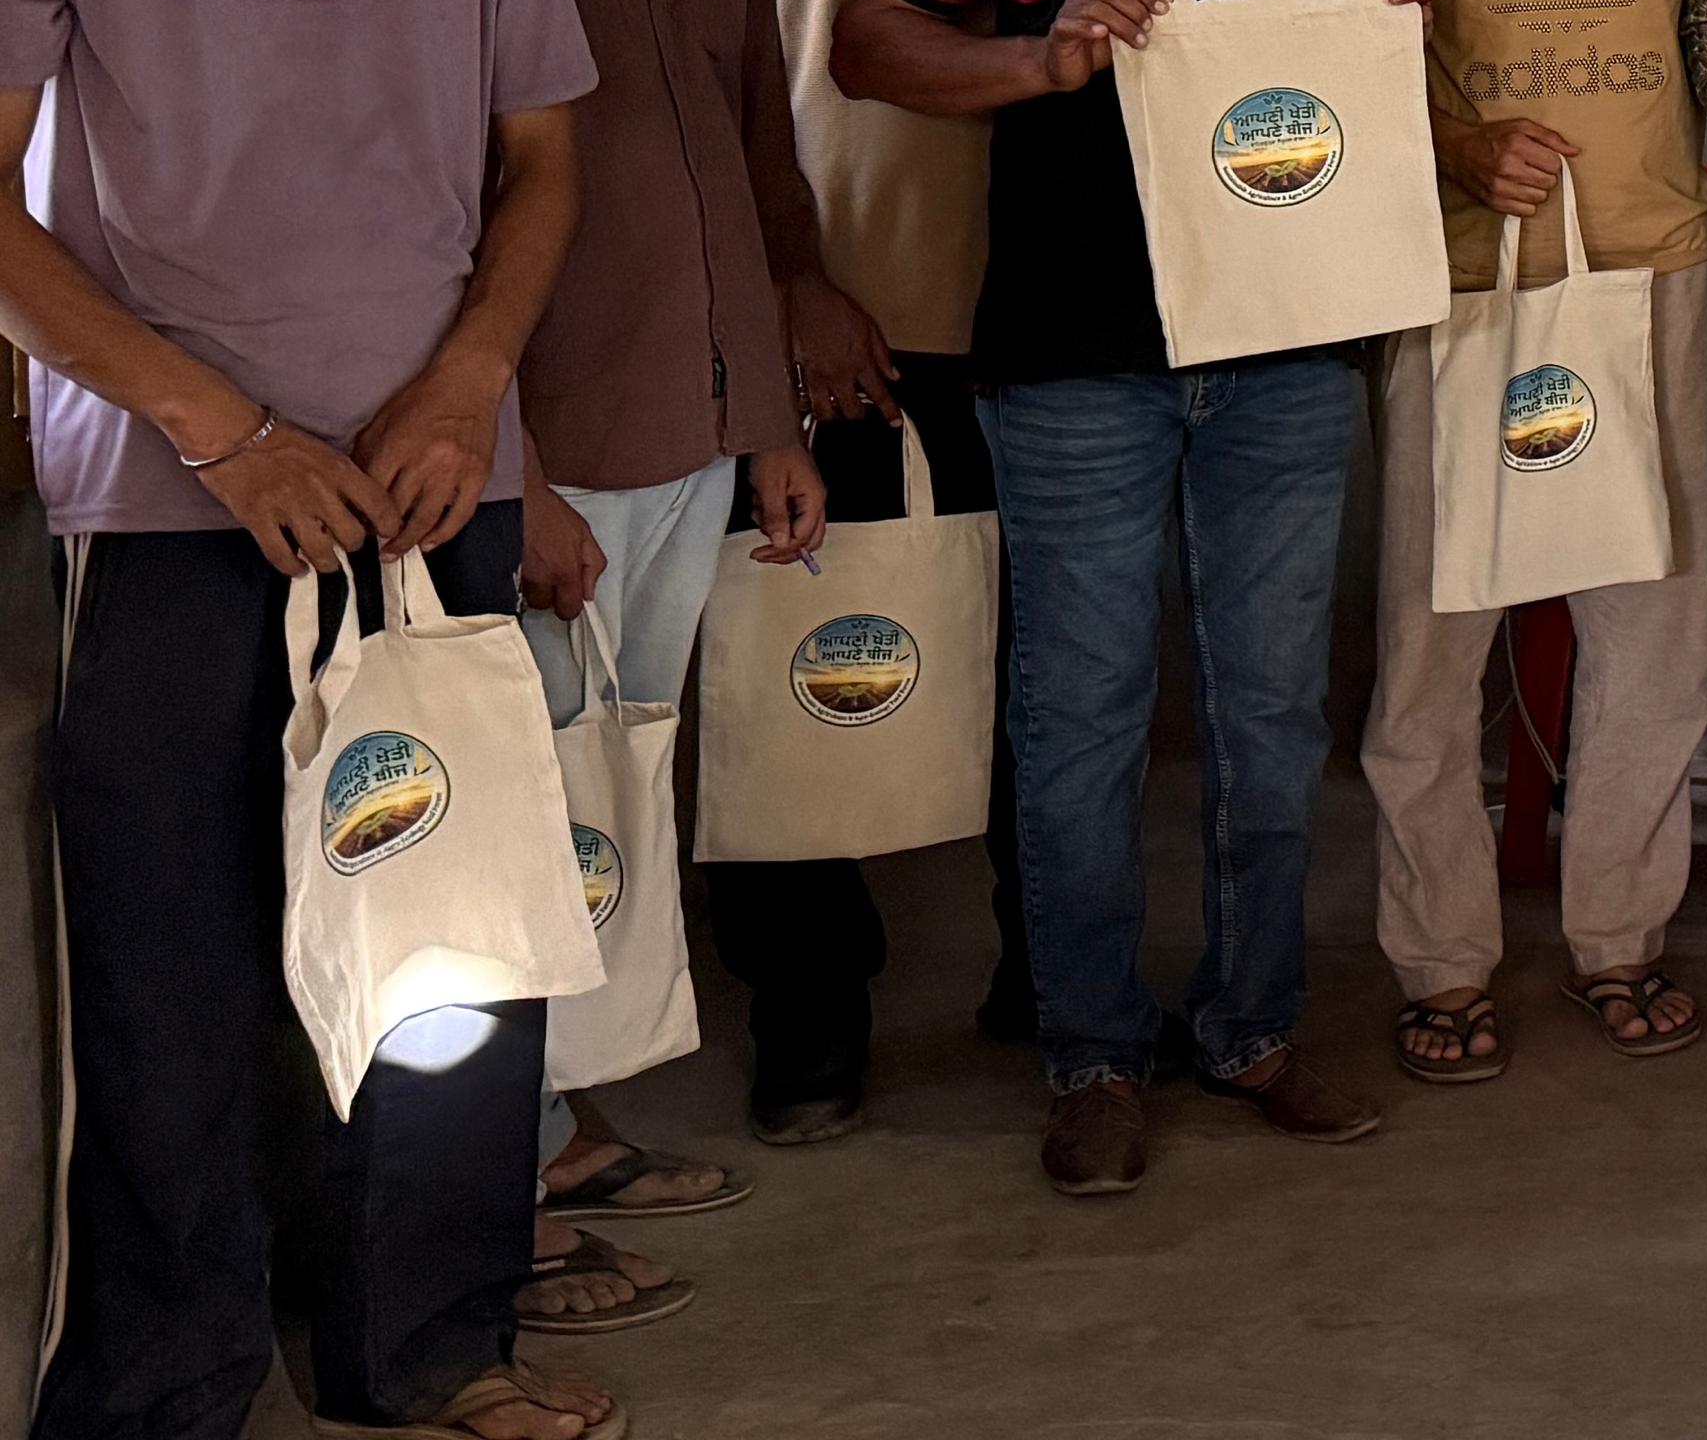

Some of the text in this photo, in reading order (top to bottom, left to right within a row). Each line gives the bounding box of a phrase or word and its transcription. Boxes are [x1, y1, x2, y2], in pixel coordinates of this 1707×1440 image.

[1463, 44, 1664, 101] adidas
[1232, 102, 1316, 127] ਆਪਣੀ ਖੇਤੀ
[1241, 120, 1312, 141] ਆਪਣੇ ਬੀਜ
[1547, 375, 1571, 391] ਖੇਤੀ
[1545, 392, 1568, 405] ਬੀਜ
[376, 741, 411, 763] ਖੇਤੀ
[373, 763, 408, 782] ਬੀਜ
